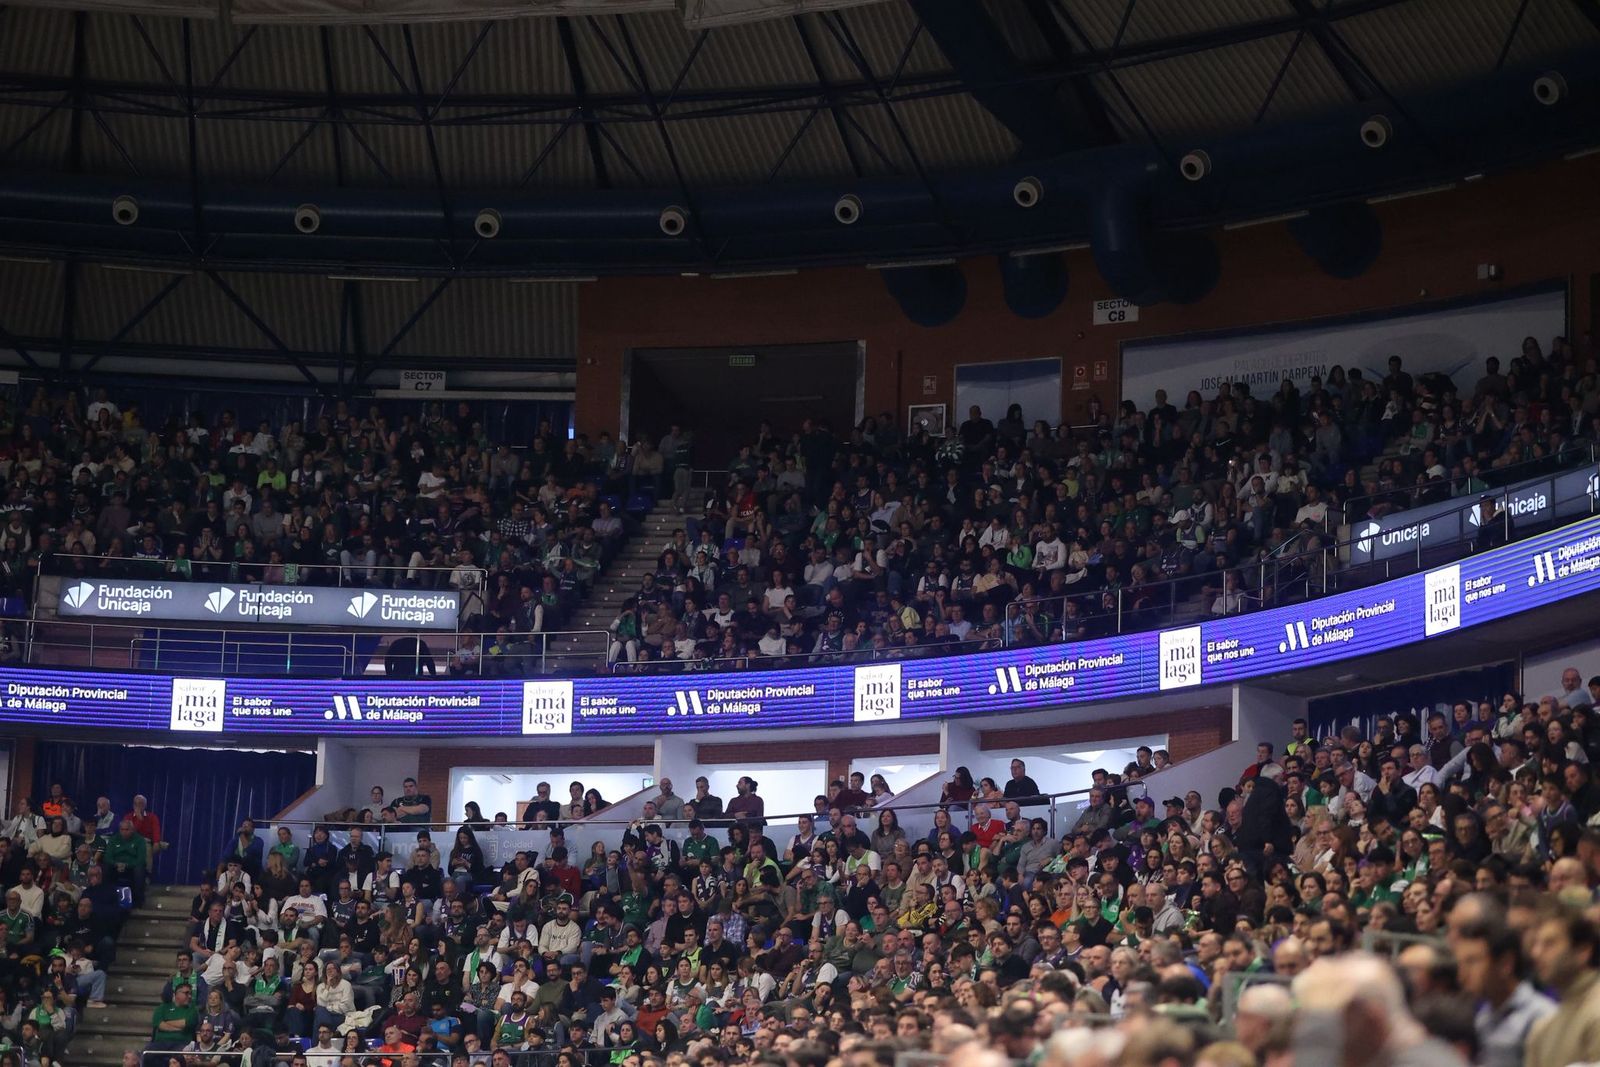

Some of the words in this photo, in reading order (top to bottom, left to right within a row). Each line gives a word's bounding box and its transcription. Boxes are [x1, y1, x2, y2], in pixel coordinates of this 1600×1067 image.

[1108, 310, 1125, 322] C8
[404, 371, 443, 380] SECTOR
[415, 381, 432, 391] C7
[1558, 562, 1570, 578] de
[99, 584, 173, 599] Fundación
[1465, 580, 1472, 591] El
[1472, 576, 1492, 589] sabor
[239, 589, 314, 604] Fundación
[381, 594, 456, 609] Fundación
[1465, 593, 1478, 604] que
[1479, 588, 1492, 598] nos
[1492, 584, 1506, 595] une
[97, 597, 151, 615] Unicaja
[238, 602, 292, 619] Unicaja
[381, 607, 434, 625] Unicaja
[1311, 610, 1355, 631] Diputación
[1356, 599, 1395, 620] Provincial
[1430, 603, 1455, 626] laga
[1311, 634, 1323, 646] de
[1323, 628, 1354, 643] Málaga
[1170, 638, 1195, 661] má
[1207, 642, 1215, 652] El
[1216, 639, 1239, 650] sabor
[1207, 653, 1222, 664] que
[1224, 650, 1238, 659] nos
[1240, 647, 1254, 656] une
[1025, 660, 1076, 677] Diputación
[1078, 653, 1123, 669] Provincial
[1165, 660, 1195, 683] laga
[8, 683, 69, 698] Diputación
[72, 687, 128, 700] Provincial
[866, 675, 893, 695] má
[908, 680, 916, 689] El
[918, 678, 943, 688] sabor
[1025, 679, 1038, 691] de
[1039, 676, 1075, 689] Málaga
[186, 690, 216, 707] má
[536, 691, 565, 709] má
[580, 697, 589, 705] El
[591, 696, 618, 706] sabor
[707, 687, 763, 702] Diputación
[765, 684, 815, 698] Provincial
[908, 690, 925, 700] que
[926, 688, 942, 697] nos
[944, 686, 960, 696] une
[7, 697, 22, 708] de
[24, 698, 67, 713] Málaga
[233, 697, 242, 705] El
[244, 697, 272, 706] sabor
[366, 695, 426, 708] Diputación
[428, 695, 481, 707] Provincial
[707, 703, 721, 714] de
[723, 702, 761, 715] Málaga
[861, 694, 893, 716] laga
[178, 704, 216, 727] laga
[232, 707, 251, 716] que
[253, 708, 271, 716] nos
[273, 708, 292, 716] une
[366, 709, 381, 720] de
[383, 709, 423, 722] Málaga
[529, 708, 565, 730] laga
[580, 707, 598, 717] que
[600, 707, 617, 715] nos
[619, 706, 636, 714] une
[503, 840, 533, 849] Ciudad
